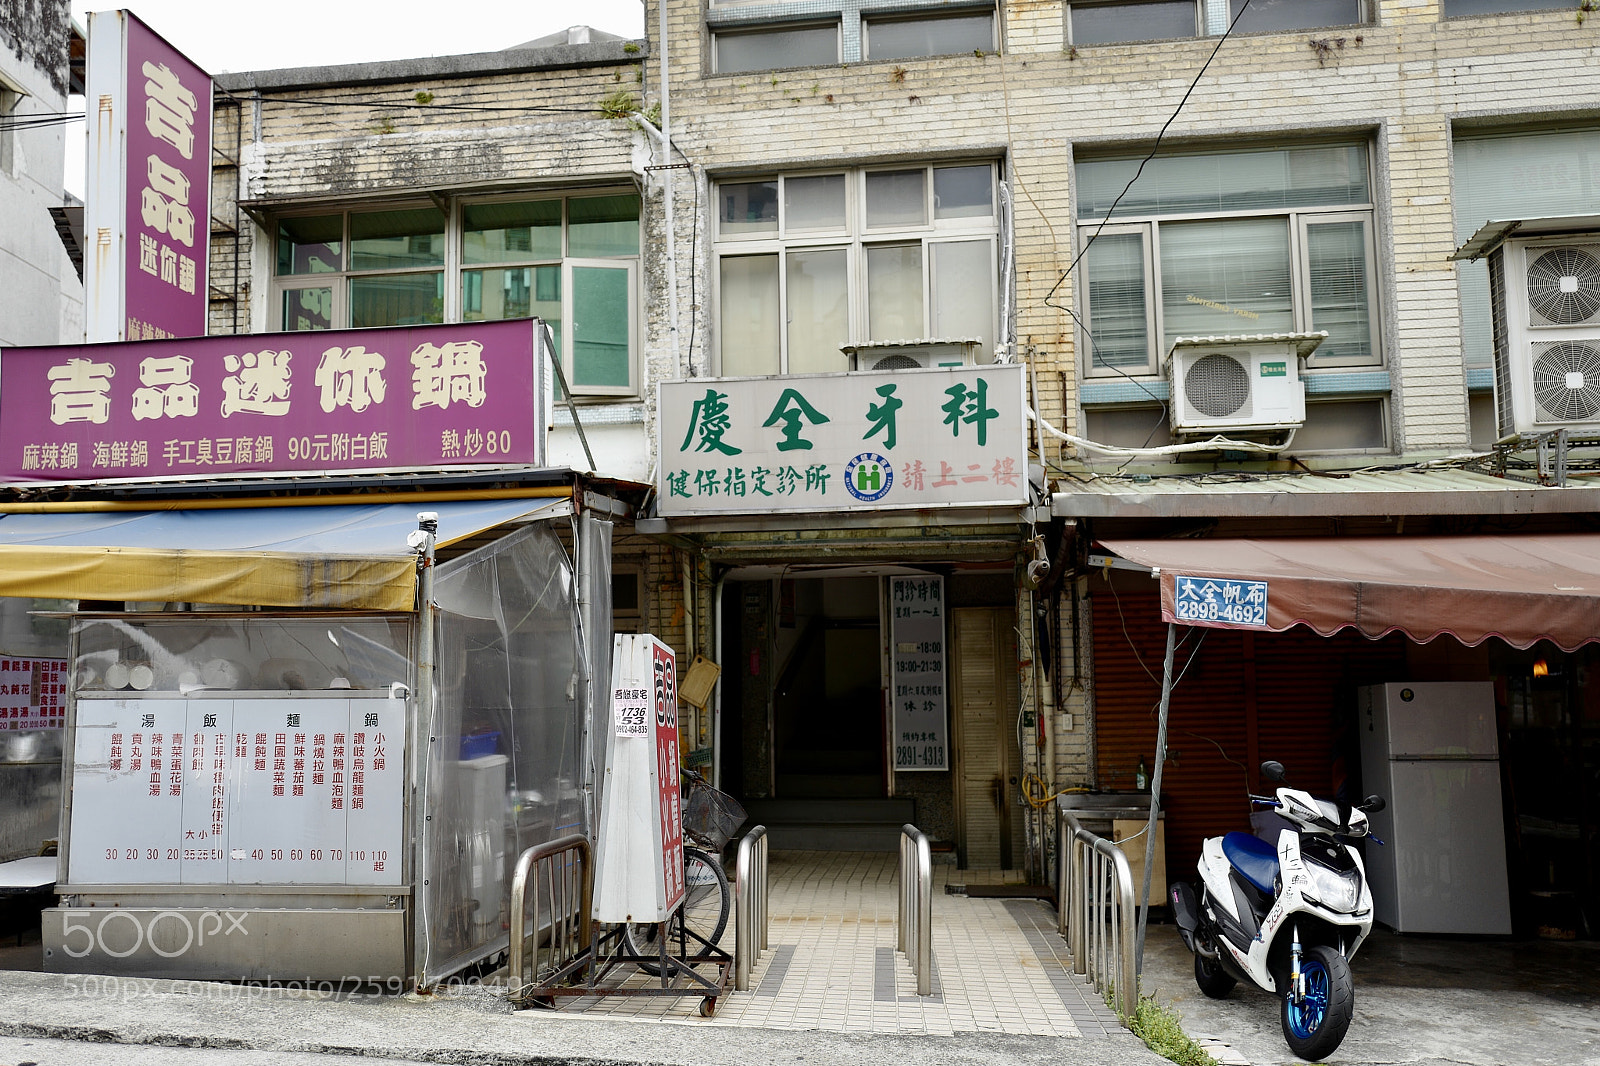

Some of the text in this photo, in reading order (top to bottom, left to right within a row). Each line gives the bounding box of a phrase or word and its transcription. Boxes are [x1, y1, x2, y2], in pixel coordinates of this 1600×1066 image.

[142, 60, 198, 248] 吉品
[140, 232, 196, 296] 迷你鍋
[47, 340, 488, 426] 吉品迷你鍋
[680, 377, 1000, 456] 慶全牙科
[22, 442, 79, 471] 麻辣鍋
[92, 440, 149, 469] 海鮮鍋
[162, 435, 274, 467] 手工臭豆腐鍋
[288, 431, 389, 462] 90元附白飯
[665, 463, 832, 498] 健保指定診所
[901, 457, 1022, 492] 請上二樓
[894, 580, 941, 602] 門診時間
[1179, 578, 1265, 607] 大全帆布
[1179, 601, 1264, 623] 2898-4692
[896, 660, 942, 673] 19:00-21:30
[142, 713, 155, 728] 湯
[203, 713, 217, 728] 飯
[286, 713, 301, 728] 麵
[364, 712, 379, 727] 鍋
[621, 707, 647, 717] 1736
[621, 716, 645, 725] 53
[110, 733, 122, 771] 餛飩湯
[130, 733, 143, 771] 貢丸湯
[149, 733, 163, 797] 辣味鴨血湯
[169, 733, 183, 797] 青菜蛋花湯
[254, 732, 267, 771] 餛飩麵
[272, 733, 286, 797] 田園蔬菜麵
[292, 732, 306, 797] 鮮味蕃茄麵
[313, 733, 326, 785] 鍋燒拉麵
[373, 732, 386, 771] 小火鍋
[896, 746, 943, 766] 2891-4313
[331, 732, 345, 810] 麻辣鴨血泡麵
[185, 829, 208, 840] 大 小
[105, 848, 118, 860] 30
[126, 848, 139, 860] 20
[146, 848, 159, 860] 30
[167, 848, 179, 860] 20
[251, 849, 264, 861] 40
[271, 849, 283, 861] 50
[290, 849, 303, 861] 60
[310, 849, 323, 861] 60
[330, 849, 343, 861] 70
[350, 850, 365, 861] 110
[371, 850, 387, 861] 110
[373, 861, 385, 872] 起
